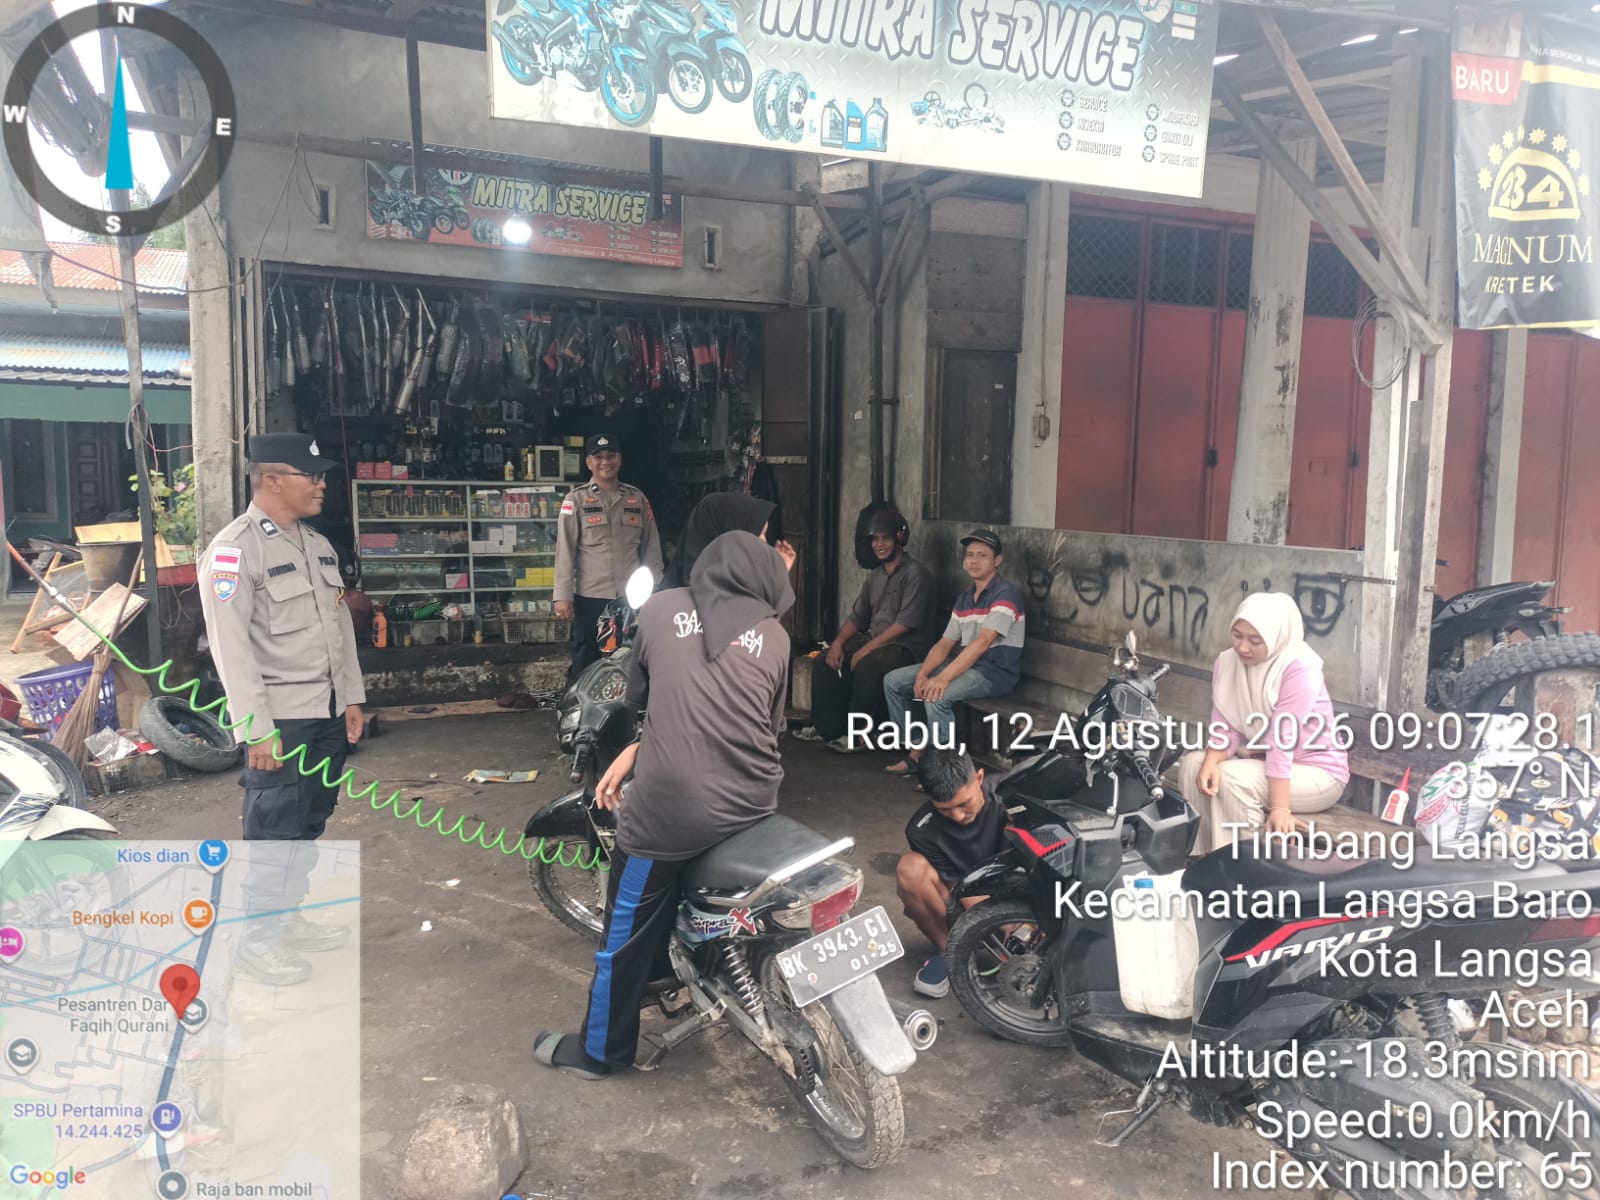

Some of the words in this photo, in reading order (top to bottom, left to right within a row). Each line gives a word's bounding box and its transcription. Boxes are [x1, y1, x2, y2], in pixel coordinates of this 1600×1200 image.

[949, 0, 1145, 91] SERVICE
[1455, 65, 1510, 95] BARU
[473, 176, 549, 213] MITRA
[555, 184, 648, 225] SERVICE
[1472, 232, 1593, 266] MAGNUM
[1484, 274, 1555, 294] KRETEK
[1245, 925, 1395, 969] VARIO
[780, 952, 810, 980] BK
